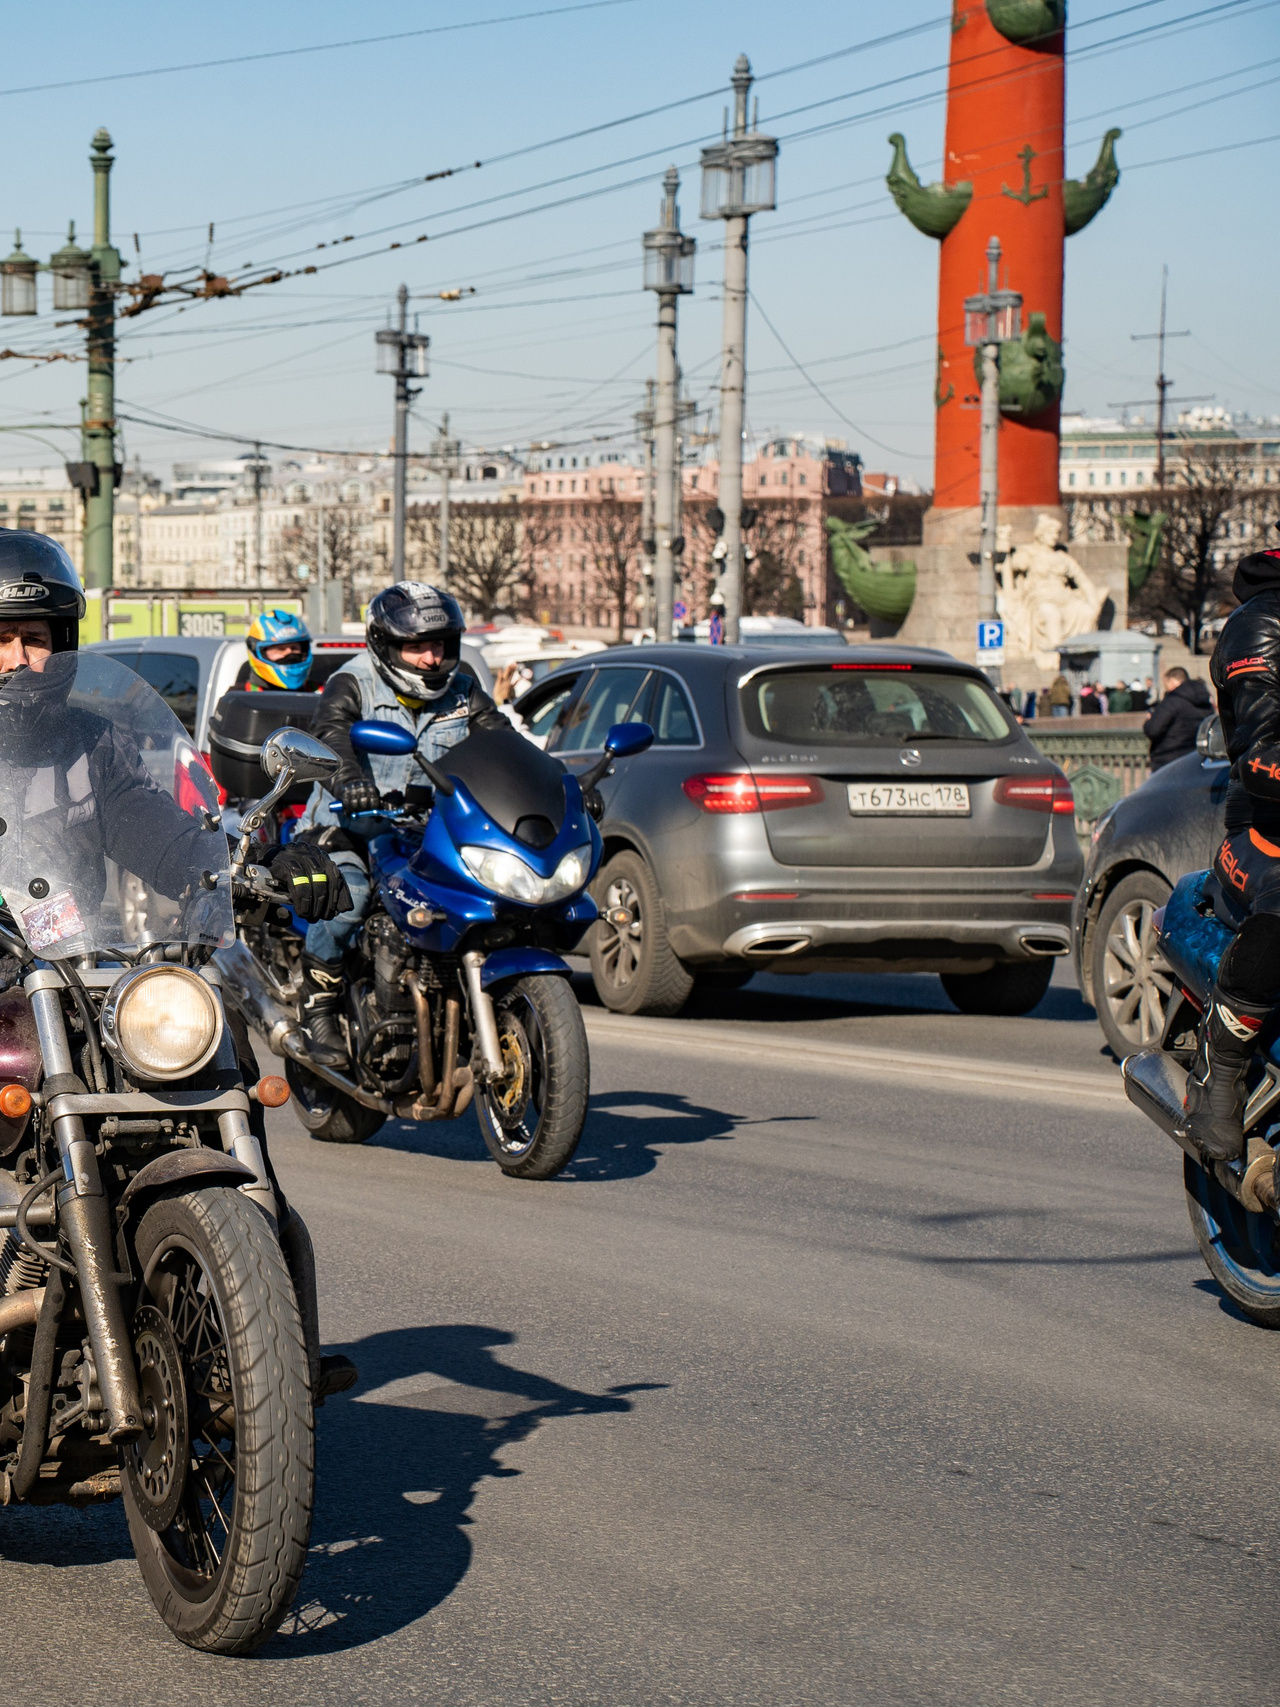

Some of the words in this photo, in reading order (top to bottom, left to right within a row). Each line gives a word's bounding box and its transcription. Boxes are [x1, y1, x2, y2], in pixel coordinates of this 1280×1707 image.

[2, 586, 43, 598] HJC
[181, 613, 224, 637] 3005
[423, 614, 446, 623] SHOEI
[984, 623, 1000, 648] P
[935, 787, 962, 802] 178
